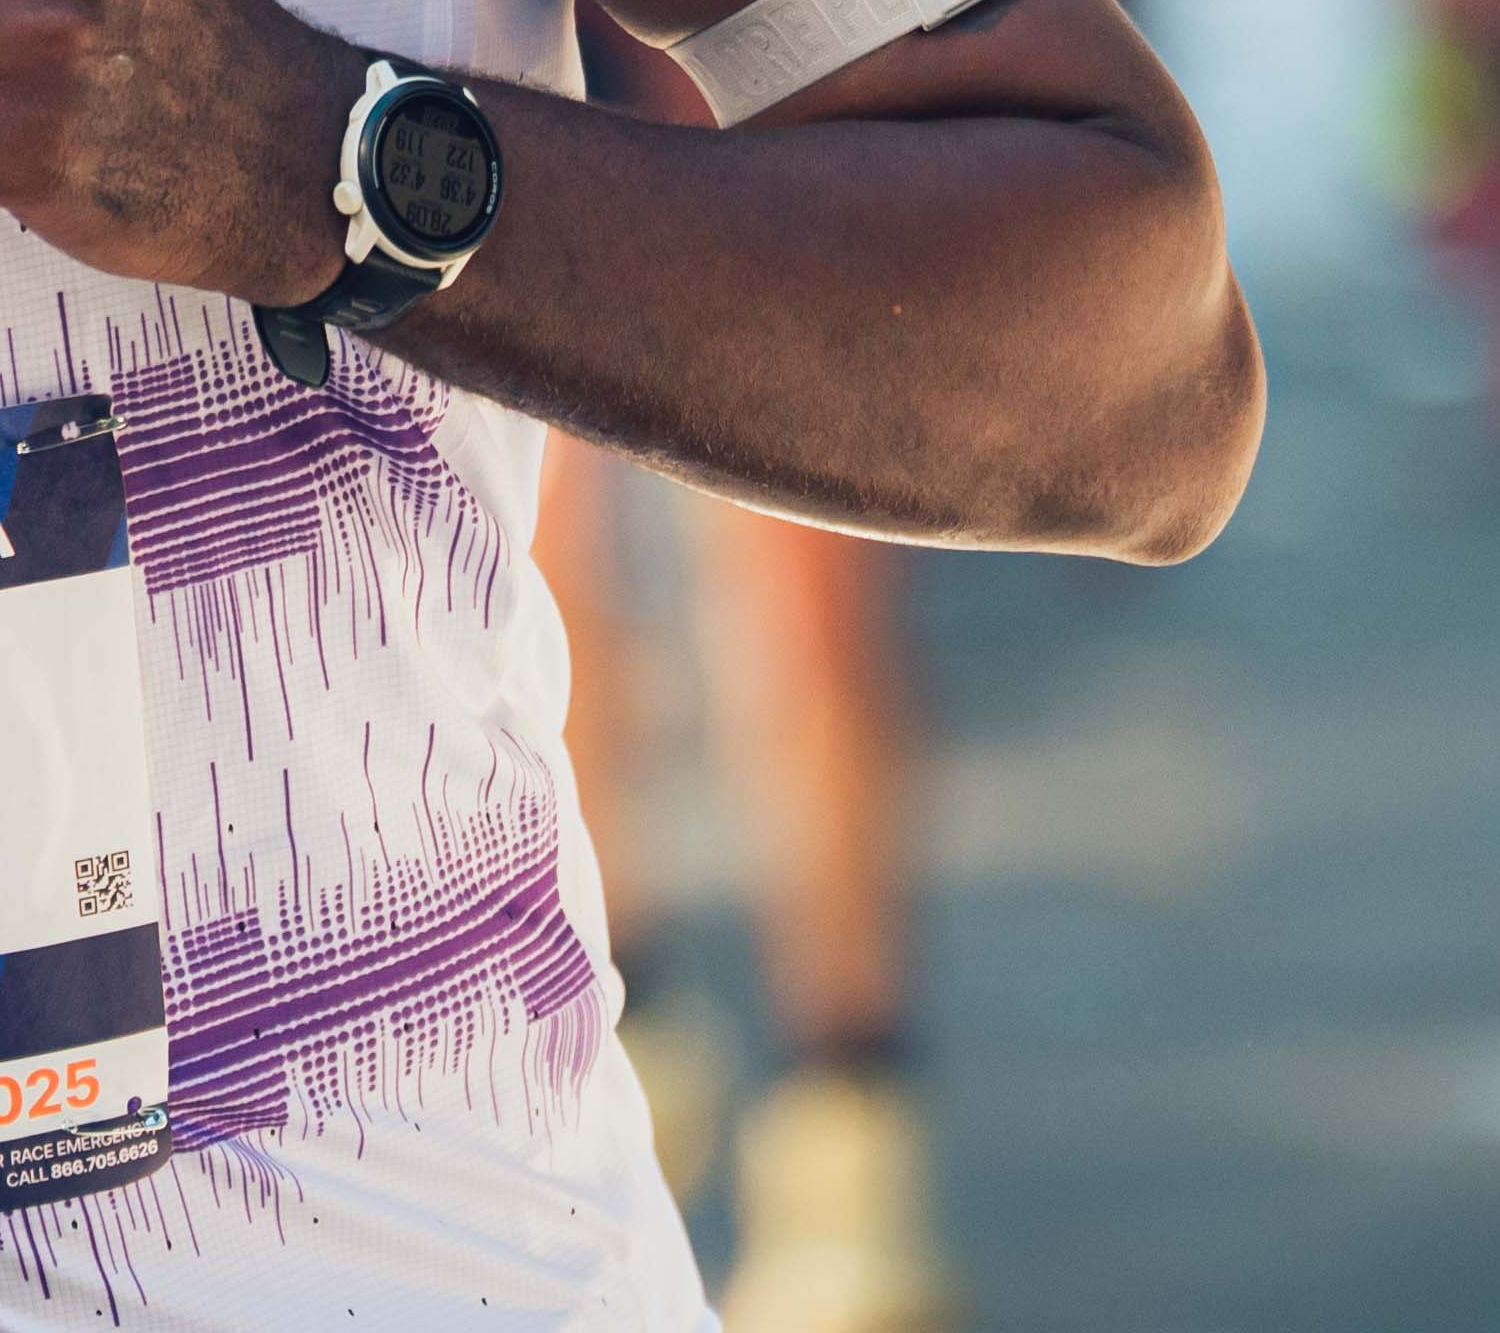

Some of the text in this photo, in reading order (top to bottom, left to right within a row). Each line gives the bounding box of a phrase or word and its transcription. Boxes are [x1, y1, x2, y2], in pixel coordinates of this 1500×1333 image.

[6, 1140, 159, 1187] CALL 866.705.6626
[10, 1143, 54, 1166] RACE
